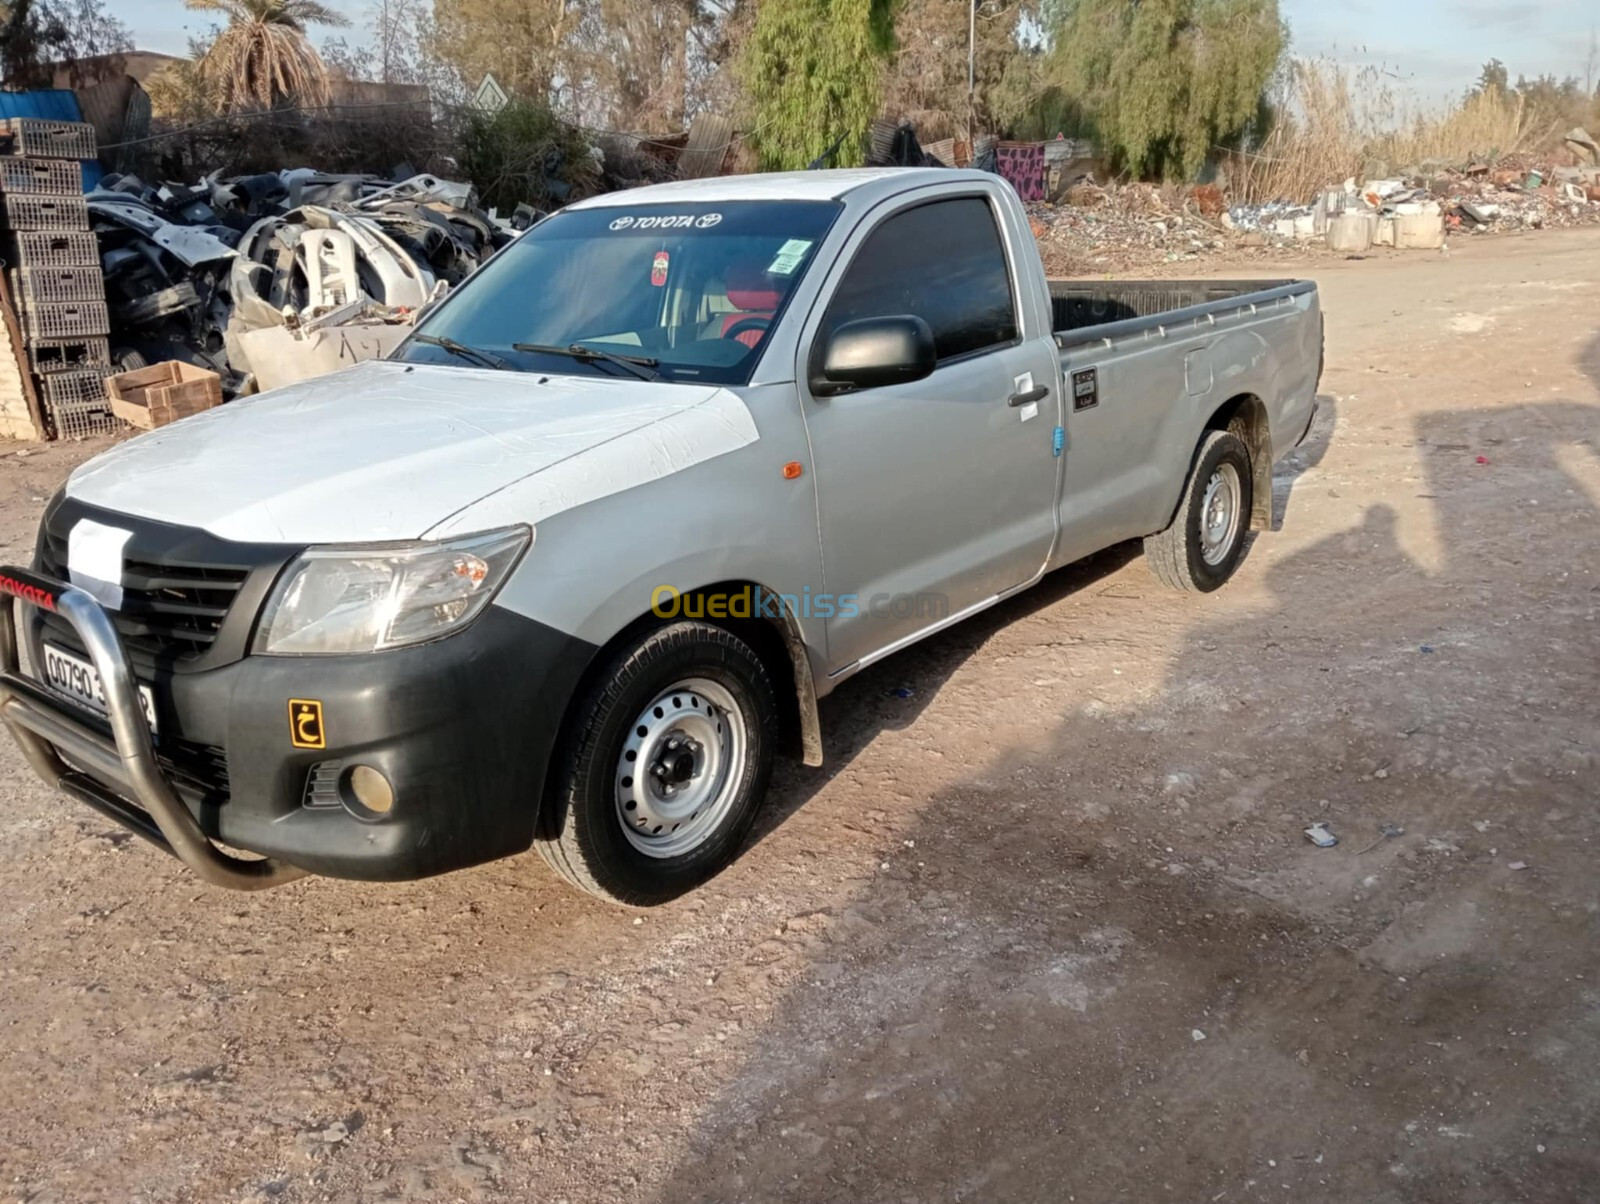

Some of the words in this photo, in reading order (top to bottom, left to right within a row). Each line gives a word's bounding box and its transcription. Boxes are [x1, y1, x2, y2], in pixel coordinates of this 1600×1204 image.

[632, 215, 694, 228] TOYOTA
[48, 652, 93, 700] 00790
[297, 704, 319, 742] خ
